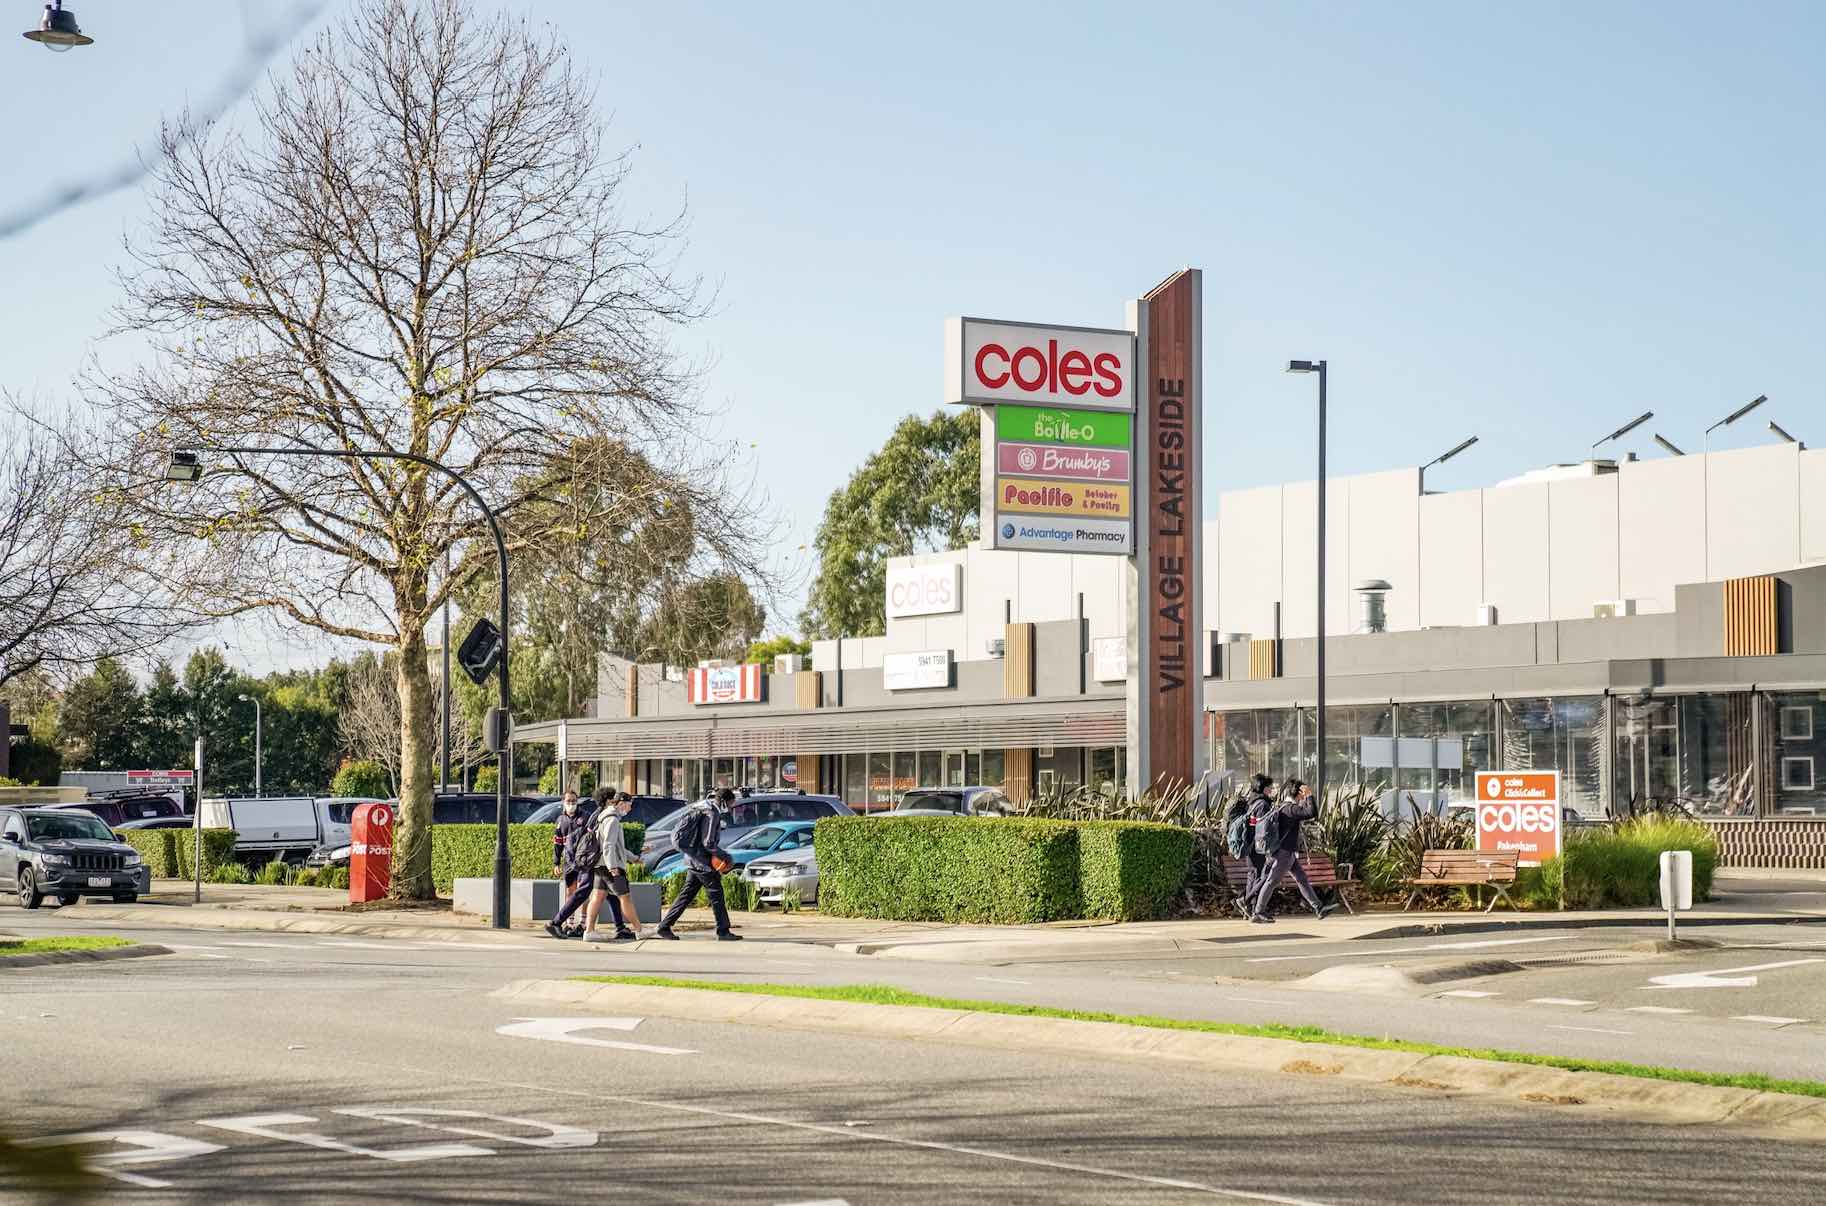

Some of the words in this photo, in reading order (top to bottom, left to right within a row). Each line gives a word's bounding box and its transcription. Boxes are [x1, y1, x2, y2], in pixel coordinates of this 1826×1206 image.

[975, 339, 1122, 397] coles
[1038, 411, 1053, 423] the
[1041, 448, 1112, 480] Brumby's
[1159, 378, 1185, 536] LAKESIDE
[1004, 484, 1074, 507] Pacific
[1019, 526, 1074, 542] Advantage
[1075, 528, 1126, 544] Pharmacy
[892, 575, 951, 608] coles
[1159, 556, 1185, 693] VILLAGE
[1480, 803, 1555, 832] coles
[369, 847, 392, 855] POST
